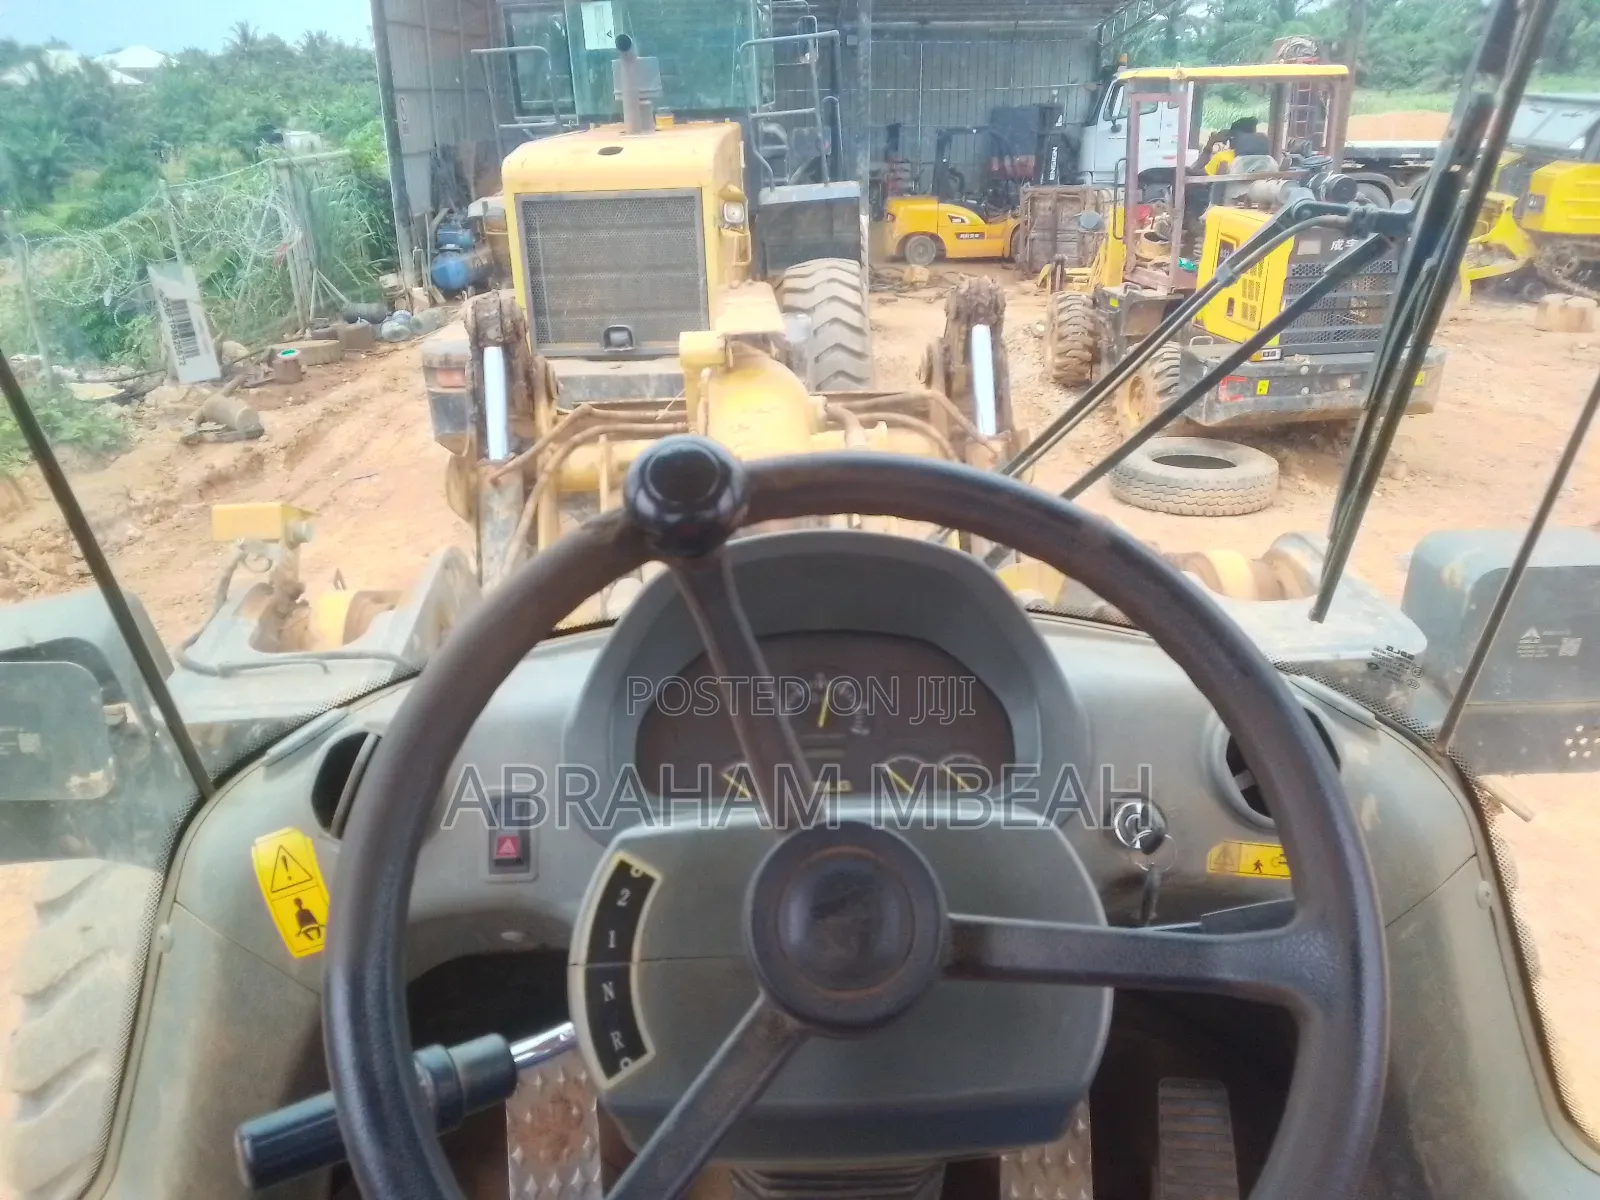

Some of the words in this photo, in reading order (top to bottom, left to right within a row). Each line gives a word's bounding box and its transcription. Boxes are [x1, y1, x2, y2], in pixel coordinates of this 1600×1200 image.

[1049, 146, 1059, 181] ENSIGN
[616, 888, 632, 907] 2
[607, 930, 617, 949] 1
[602, 981, 616, 1002] N
[610, 1030, 626, 1051] R
